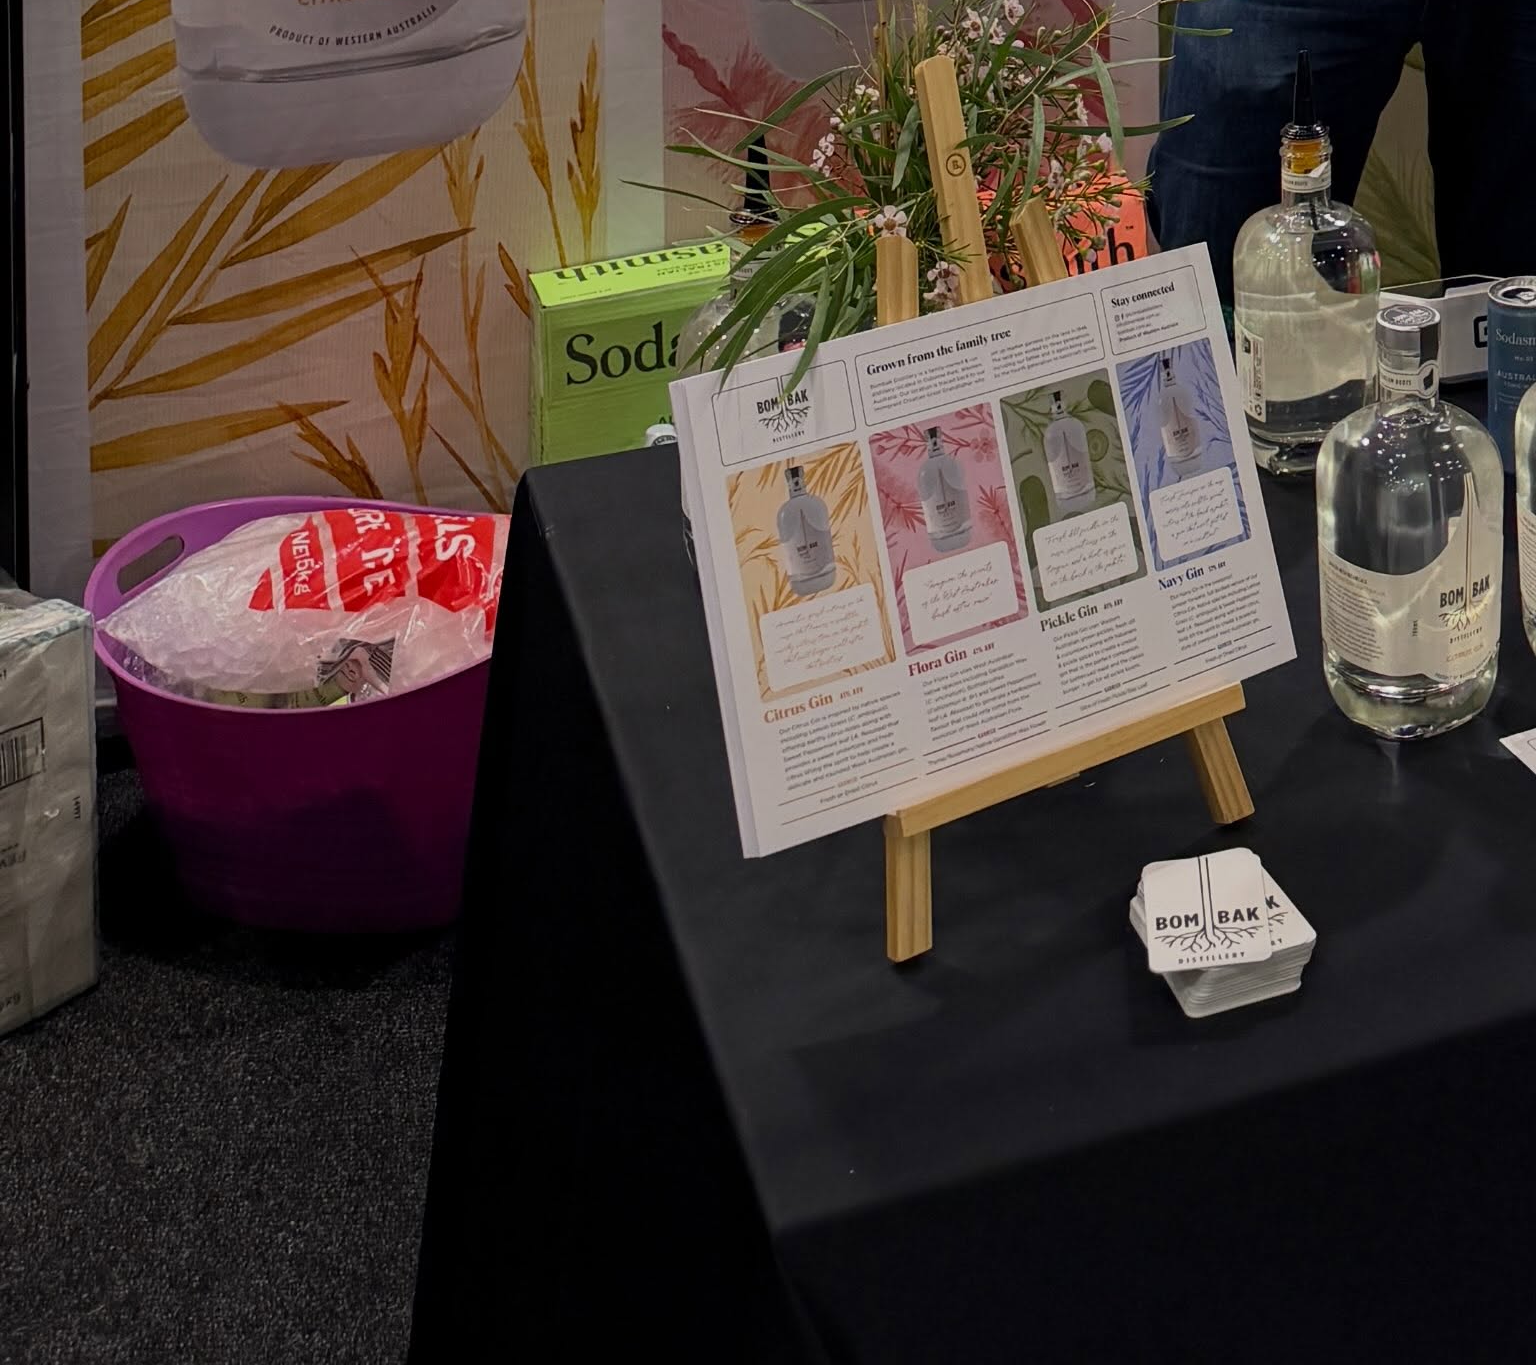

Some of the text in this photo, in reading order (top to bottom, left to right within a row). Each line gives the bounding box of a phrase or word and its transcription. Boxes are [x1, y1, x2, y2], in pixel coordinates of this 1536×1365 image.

[268, 24, 315, 46] PRODUCT
[335, 31, 383, 47] WESTERN
[386, 3, 438, 37] AUSTRALIA
[1111, 281, 1175, 309] Stay connected
[866, 328, 1012, 376] Grown from the family tree
[1157, 567, 1205, 592] Navy Gin
[1439, 574, 1491, 609] BOM BAK
[1040, 604, 1099, 632] Pickle Gin
[908, 648, 968, 677] Flora Gin
[763, 693, 834, 725] Citrus Gin
[1155, 906, 1261, 932] BOM BAK
